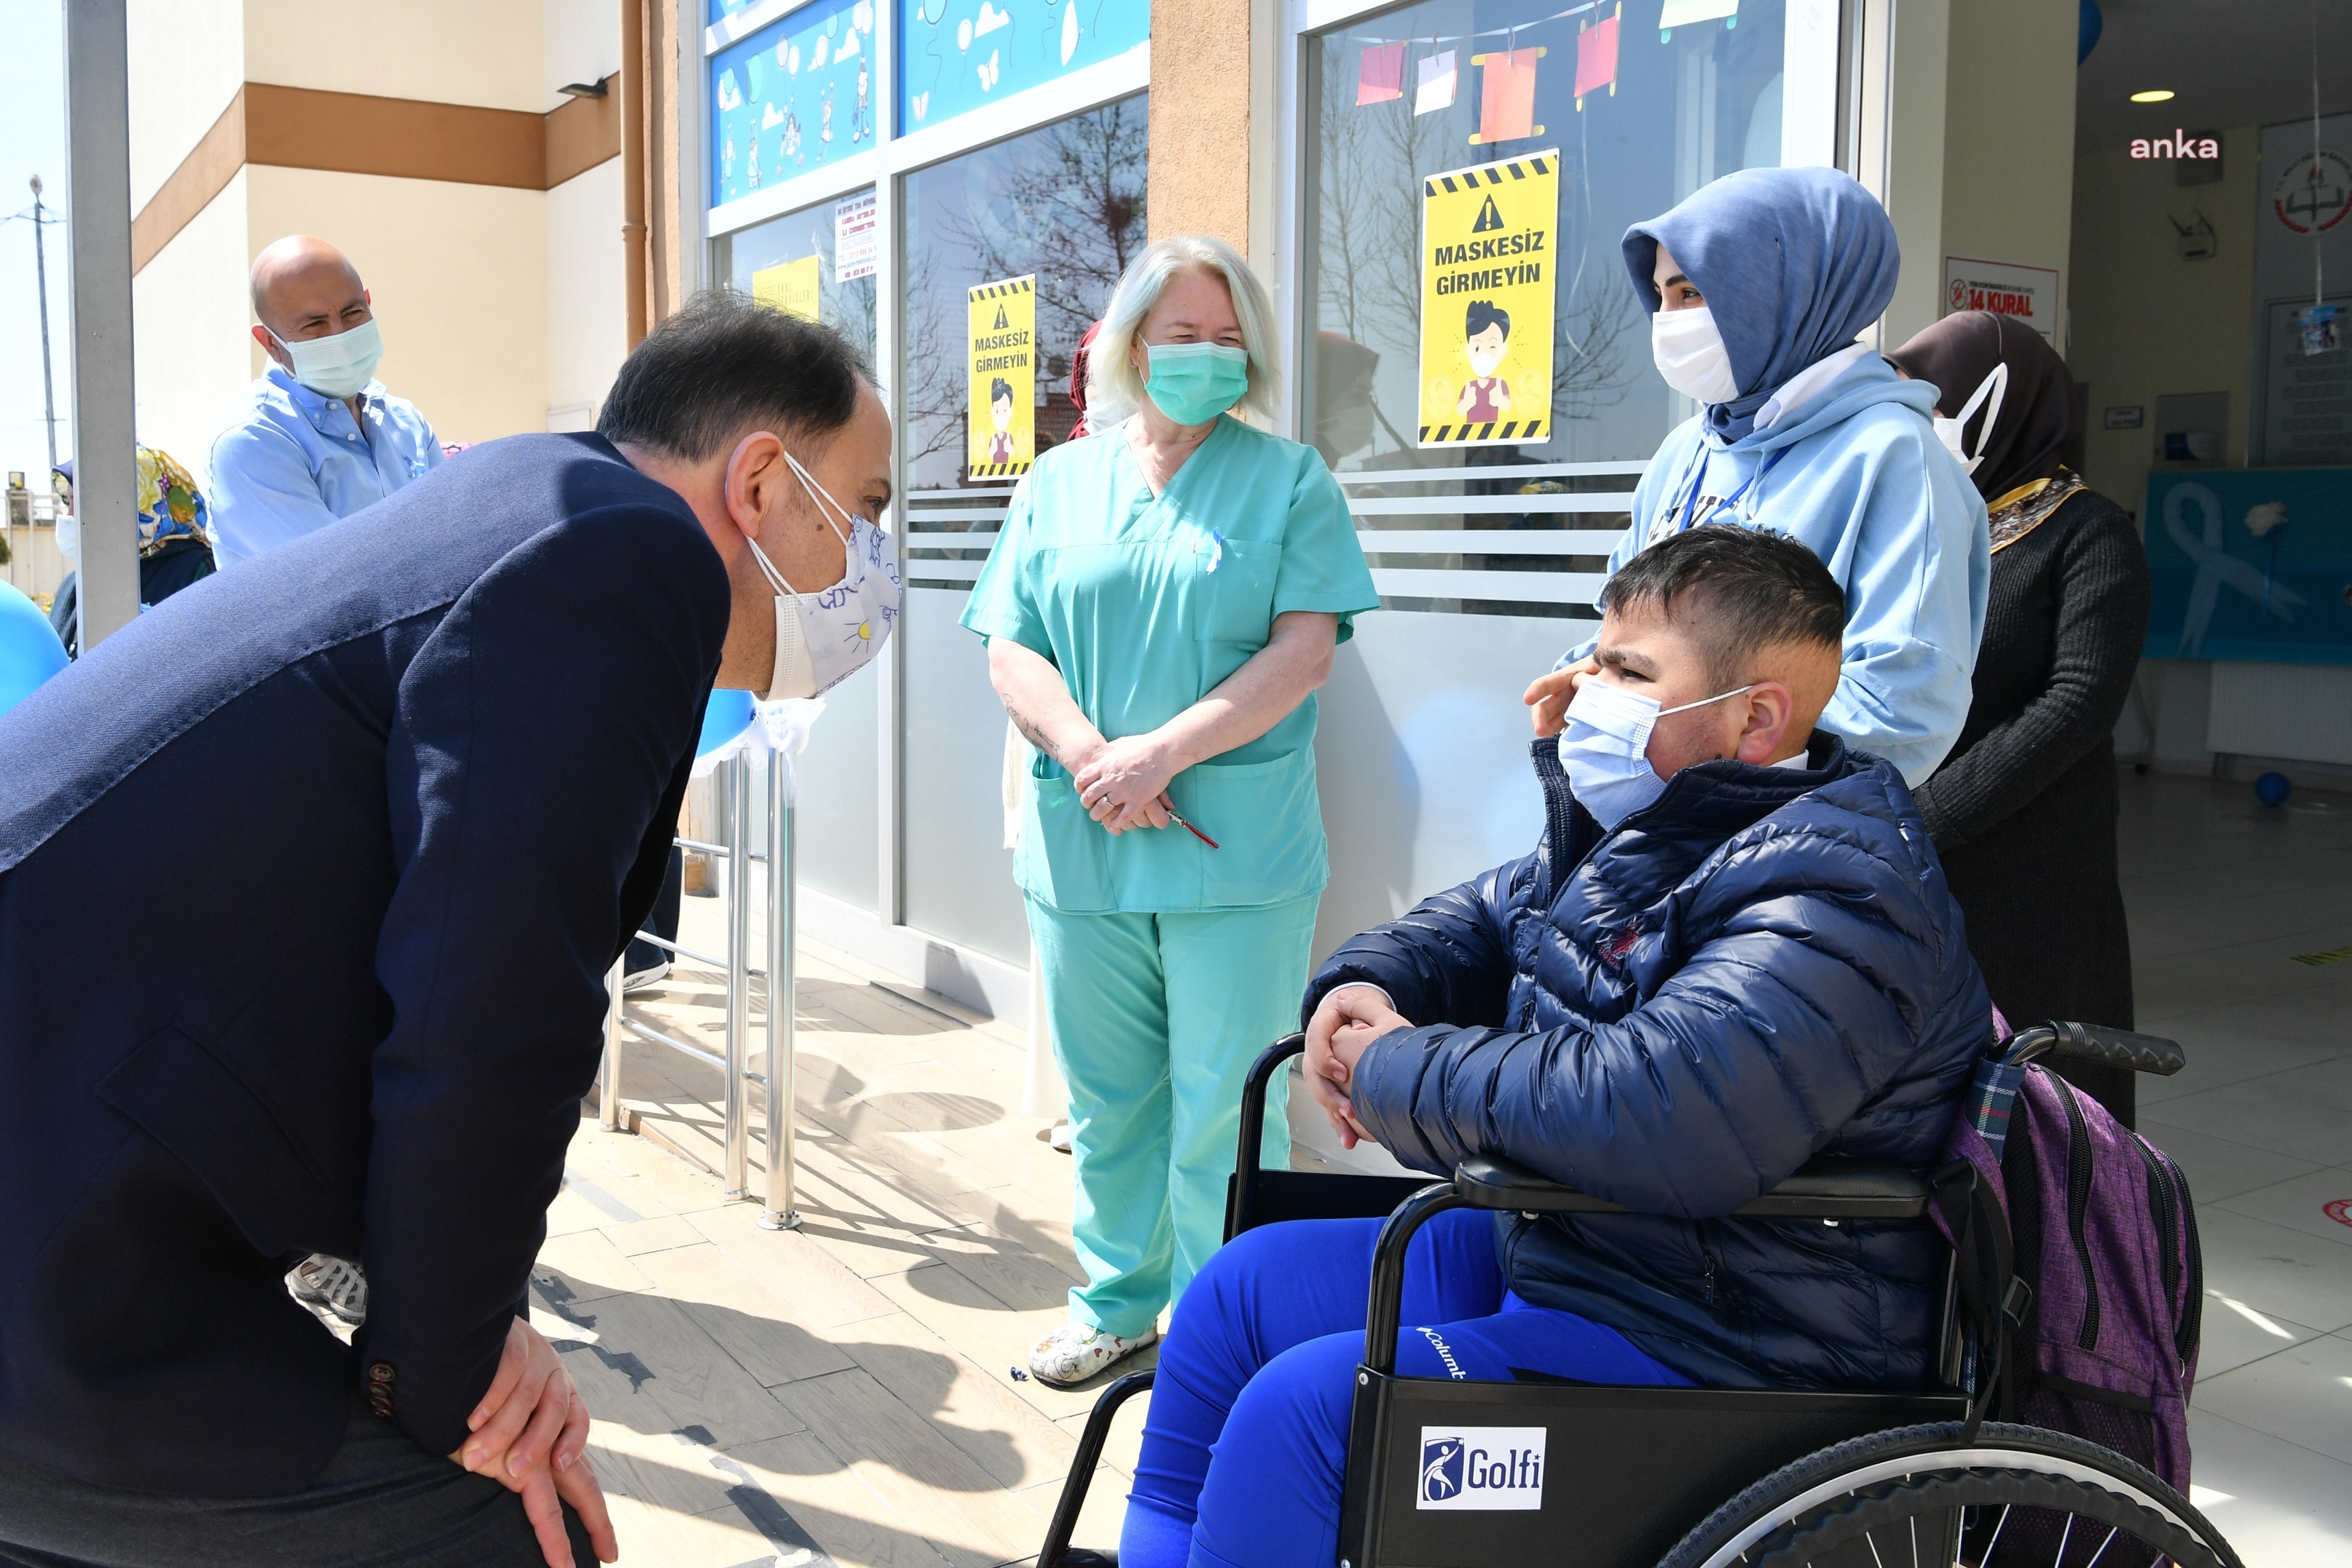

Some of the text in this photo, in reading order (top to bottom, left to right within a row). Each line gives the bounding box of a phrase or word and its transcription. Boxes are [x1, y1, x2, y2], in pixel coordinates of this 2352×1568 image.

[1435, 228, 1544, 266] MASKESİZ
[1436, 260, 1540, 296] GİRMEYİN
[1969, 288, 2034, 317] 14 KURAL
[975, 328, 1029, 353] MASKESİZ
[976, 350, 1027, 373] GİRMEYİN
[1467, 1448, 1541, 1489] Golfi
